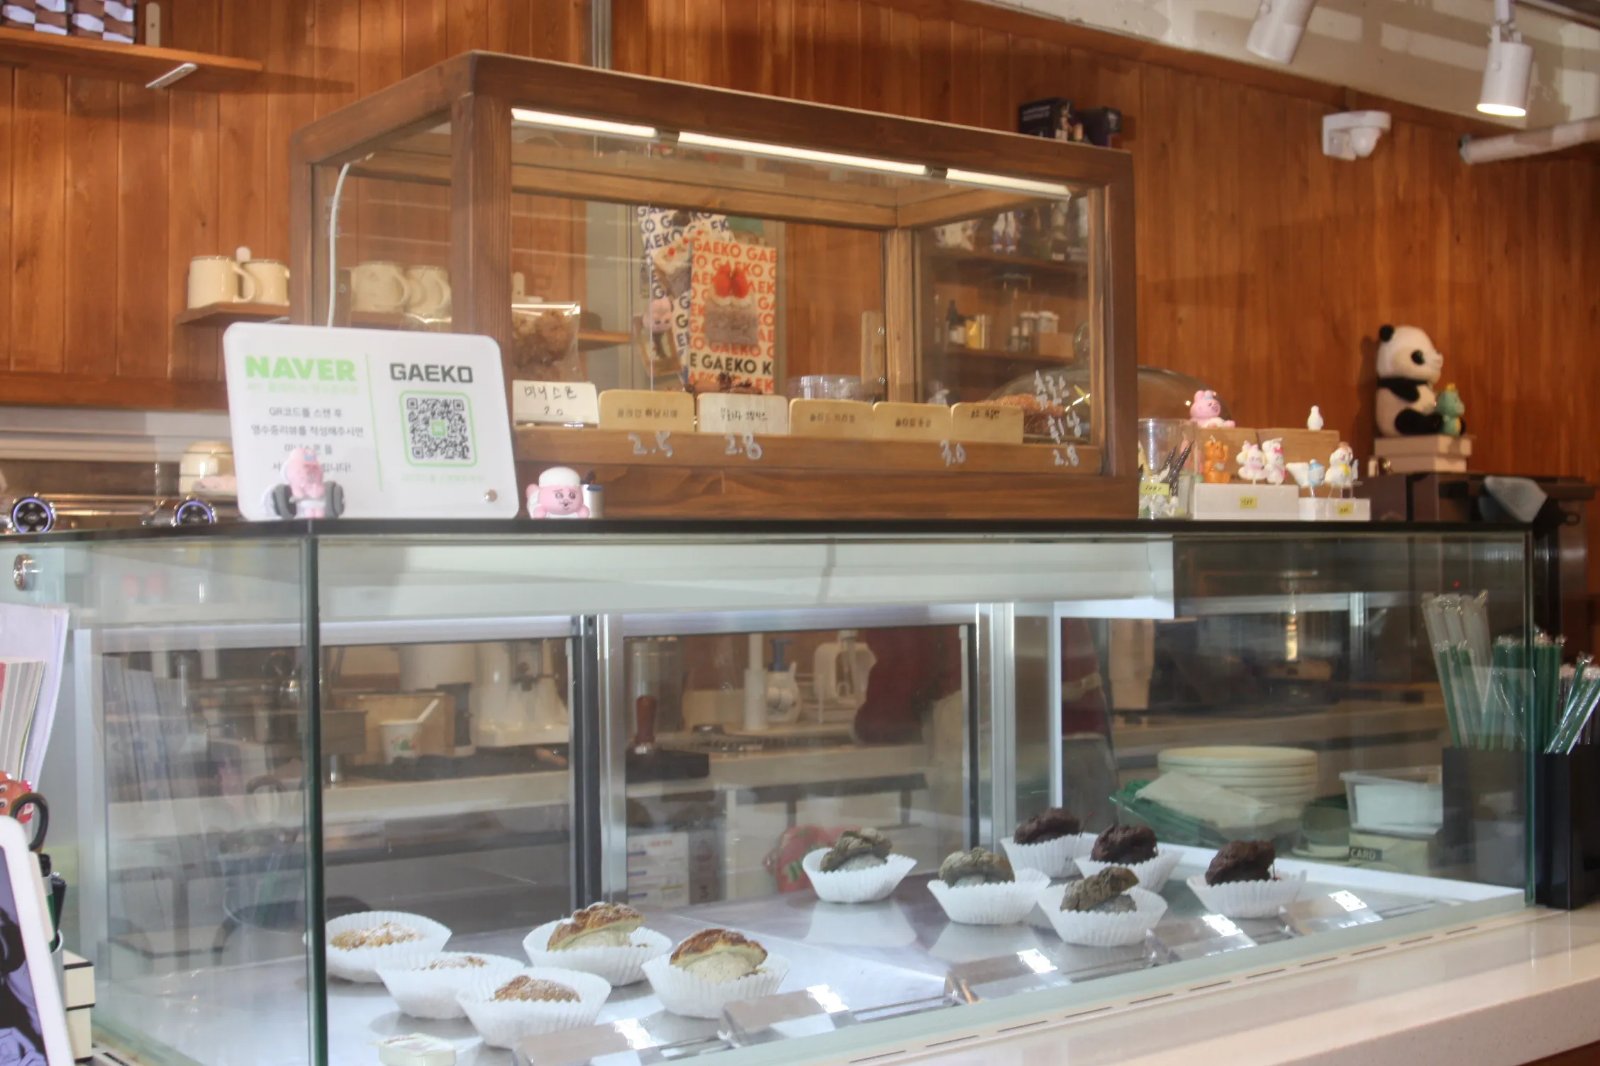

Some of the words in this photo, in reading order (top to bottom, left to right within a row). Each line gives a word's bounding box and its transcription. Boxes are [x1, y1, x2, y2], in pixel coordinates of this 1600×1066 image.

[692, 240, 741, 258] GAEKO
[244, 355, 357, 382] NAVER
[389, 362, 474, 383] GAEKO
[702, 354, 757, 374] GAEKO
